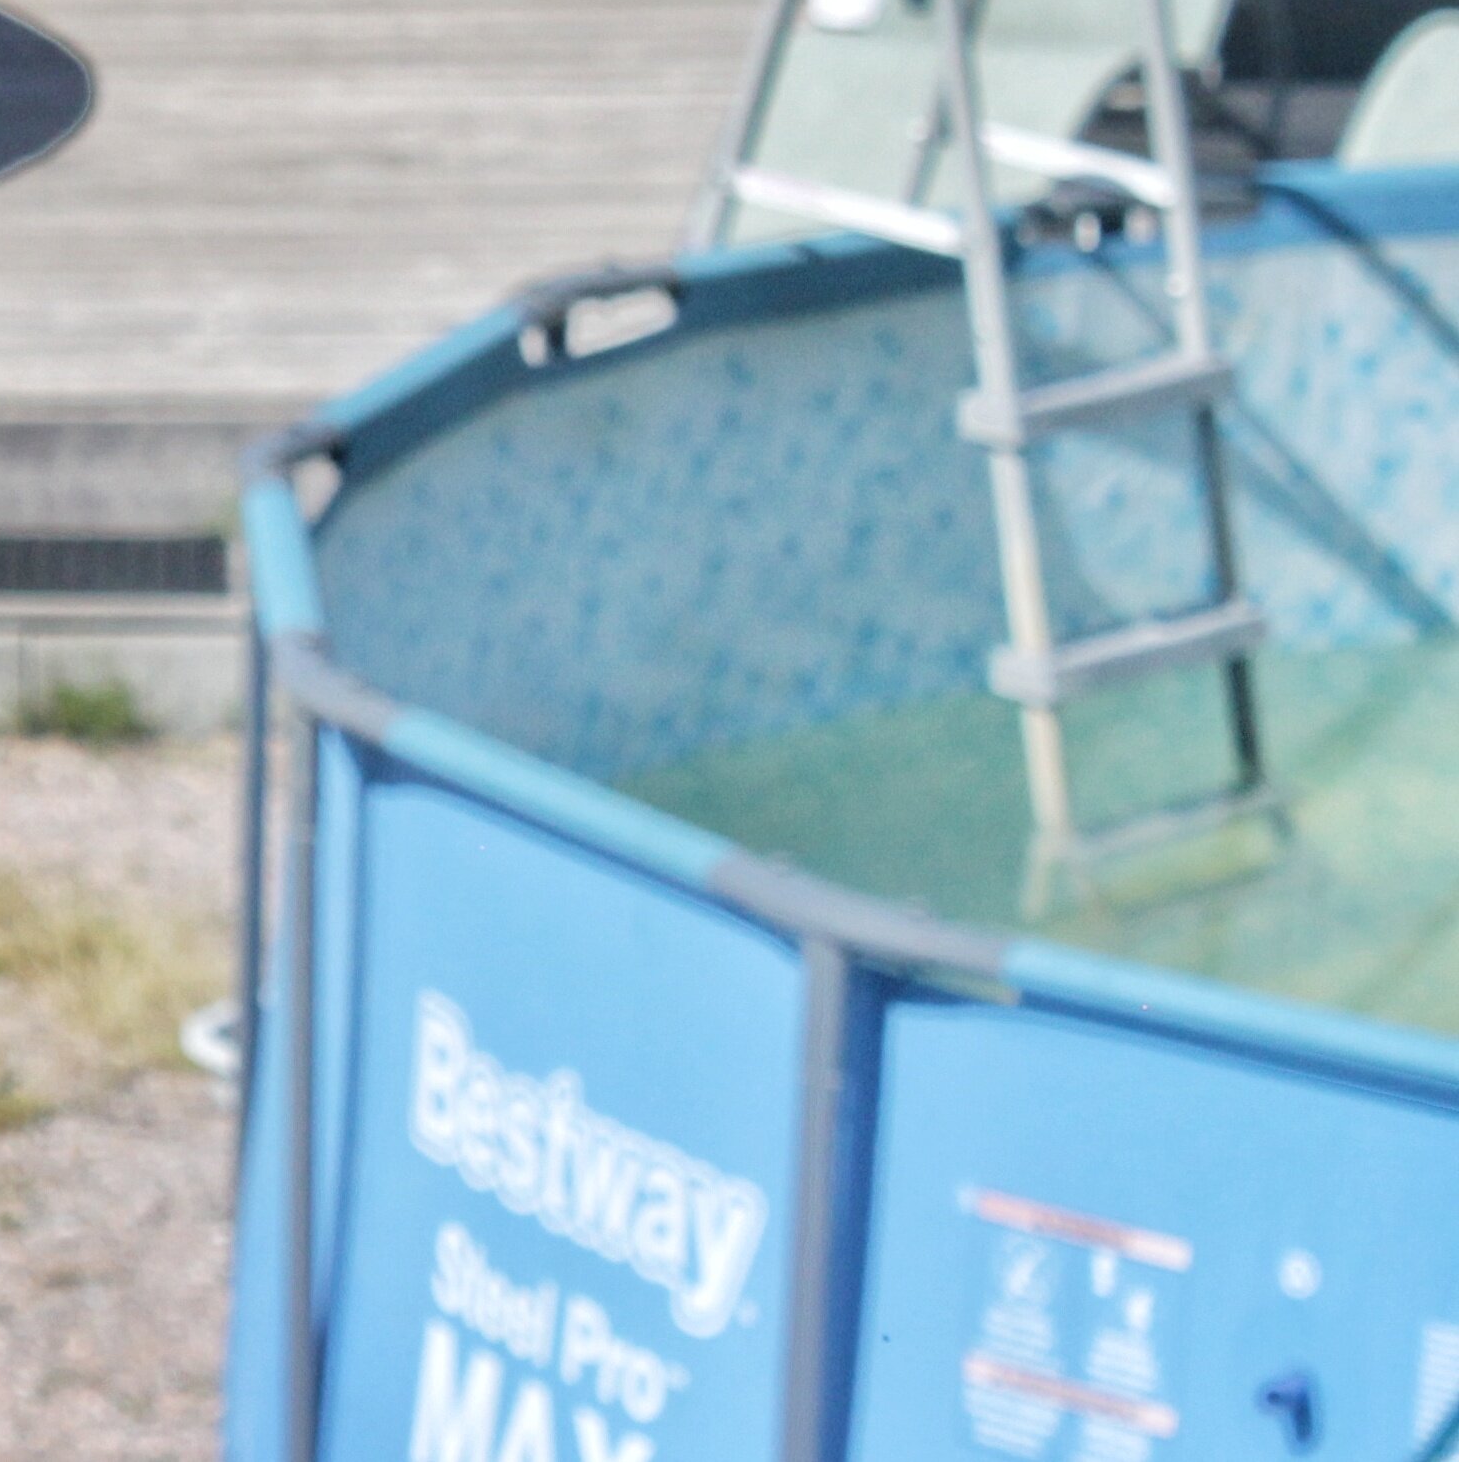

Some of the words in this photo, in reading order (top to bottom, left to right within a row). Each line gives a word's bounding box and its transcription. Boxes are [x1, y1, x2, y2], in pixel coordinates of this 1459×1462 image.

[410, 990, 766, 1337] Bestway
[431, 1222, 559, 1368] Steel
[560, 1294, 668, 1423] Pro
